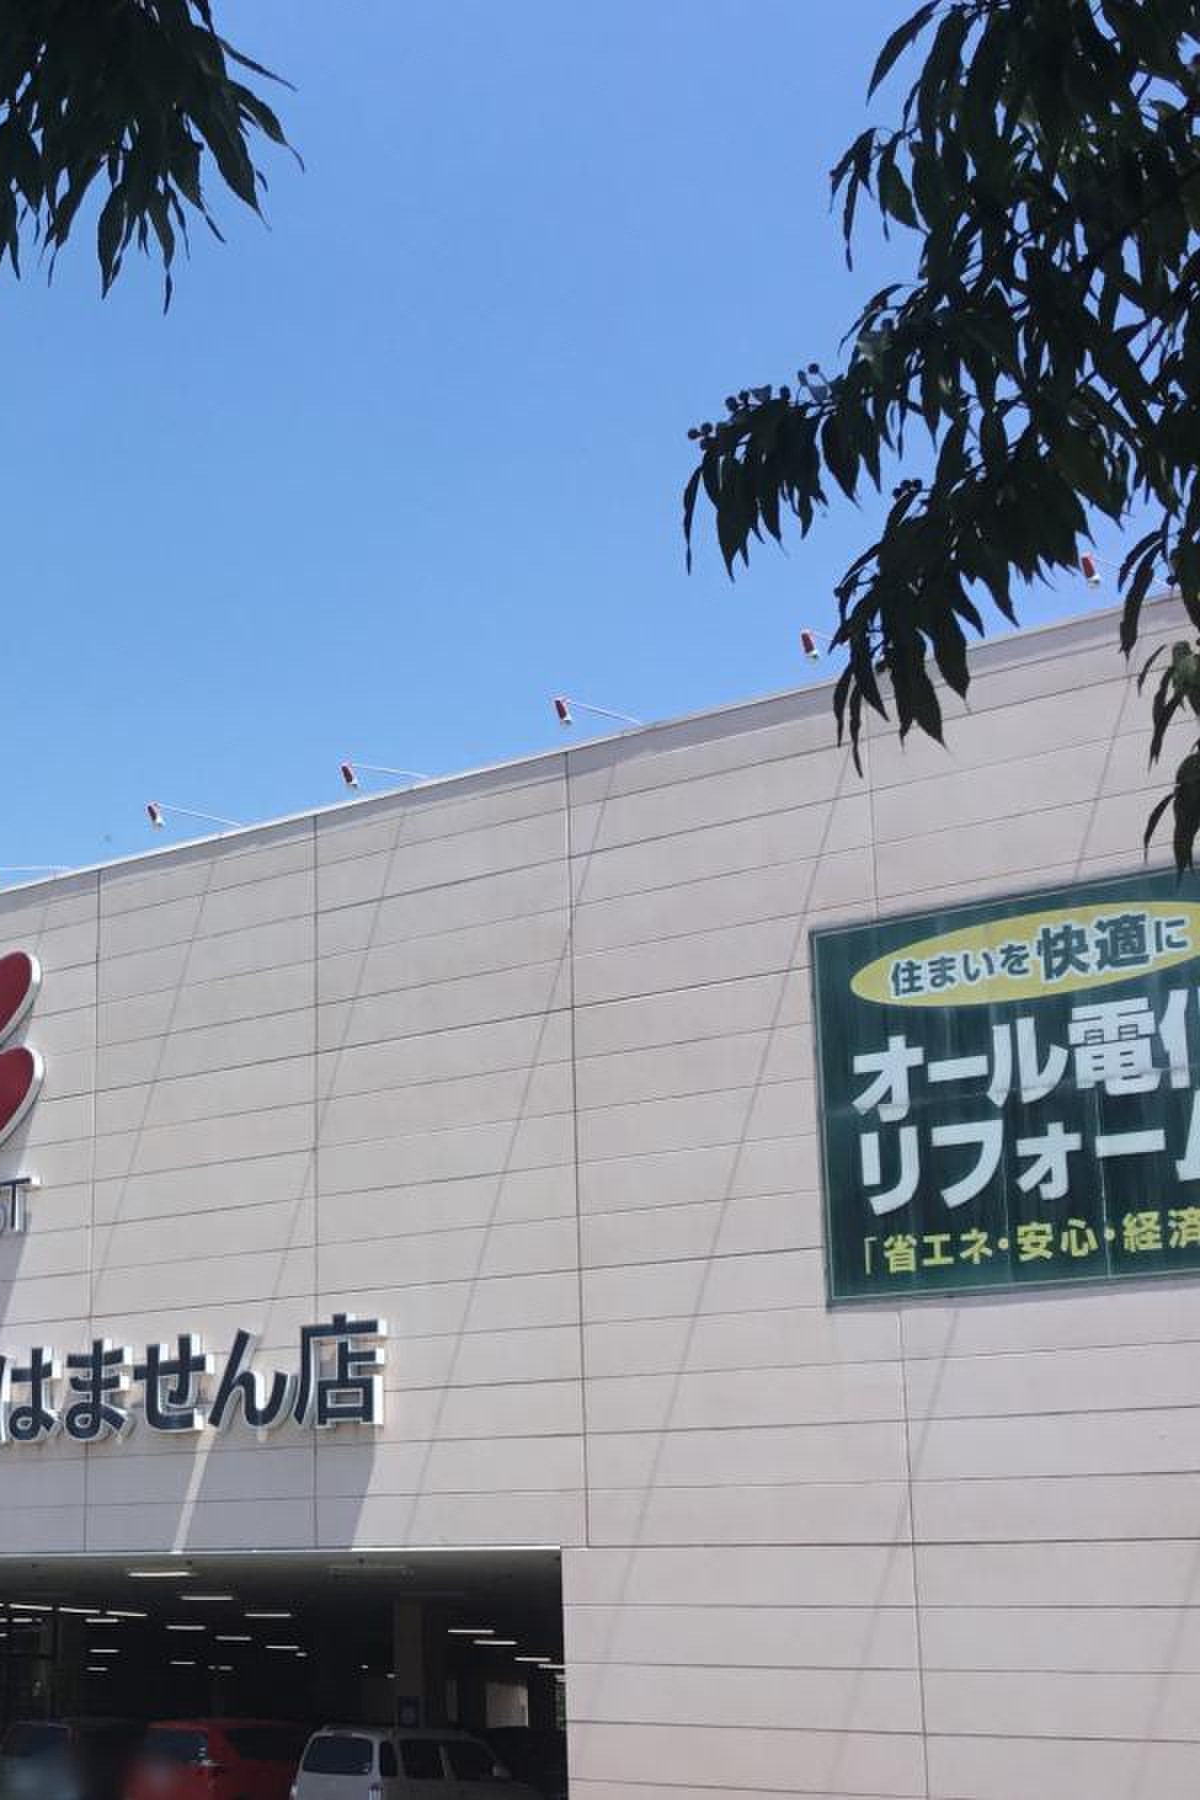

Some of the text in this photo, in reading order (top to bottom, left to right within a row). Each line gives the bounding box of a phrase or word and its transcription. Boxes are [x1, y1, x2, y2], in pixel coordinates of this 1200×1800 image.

[891, 913, 1189, 997] 住まいを快適に
[860, 1089, 1200, 1216] リフォー
